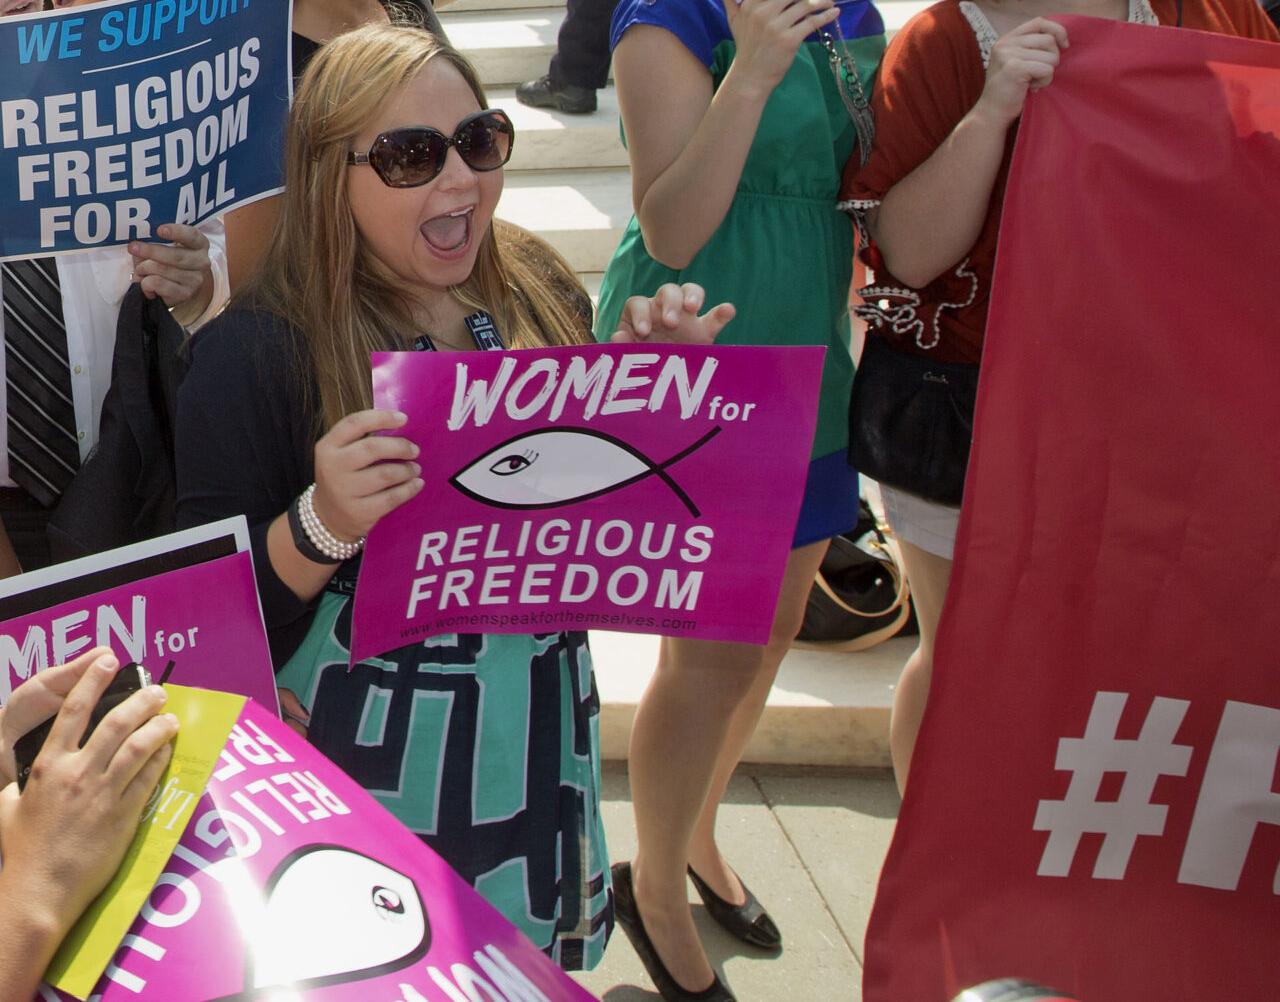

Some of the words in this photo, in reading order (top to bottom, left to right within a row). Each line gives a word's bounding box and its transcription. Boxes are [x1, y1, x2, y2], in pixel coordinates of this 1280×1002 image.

[16, 17, 85, 64] WE
[1, 37, 261, 149] RELIGIOUS
[17, 94, 250, 202] FREEDOM
[40, 198, 152, 248] FOR
[174, 159, 235, 226] ALL
[447, 353, 720, 431] WOMEN
[708, 396, 756, 422] for
[415, 518, 714, 571] RELIGIOUS
[400, 611, 697, 639] www.womenspeakforthemselves.com
[406, 562, 704, 620] FREEDOM
[154, 626, 199, 657] for
[104, 770, 352, 994] RELIGIOU
